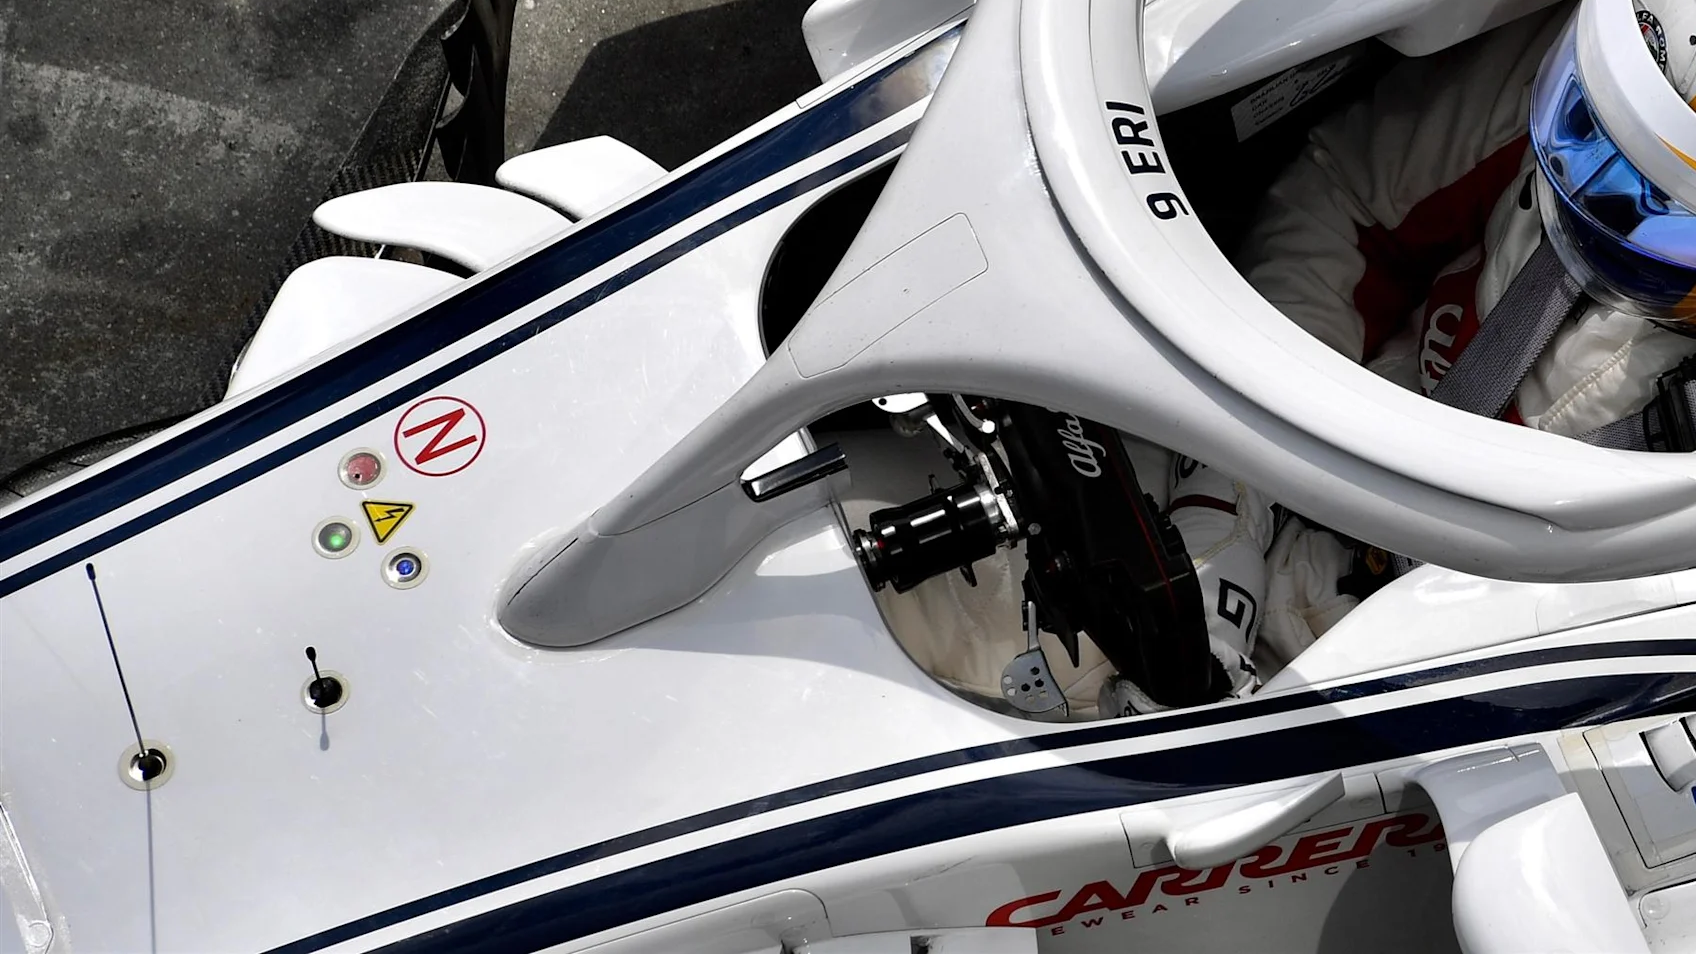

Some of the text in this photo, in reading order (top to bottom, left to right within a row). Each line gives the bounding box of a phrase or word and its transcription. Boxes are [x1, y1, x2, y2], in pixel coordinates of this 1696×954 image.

[1105, 100, 1190, 220] 9 ERI
[402, 407, 478, 466] N
[985, 812, 1448, 928] CARRER
[1239, 859, 1370, 895] SINCE
